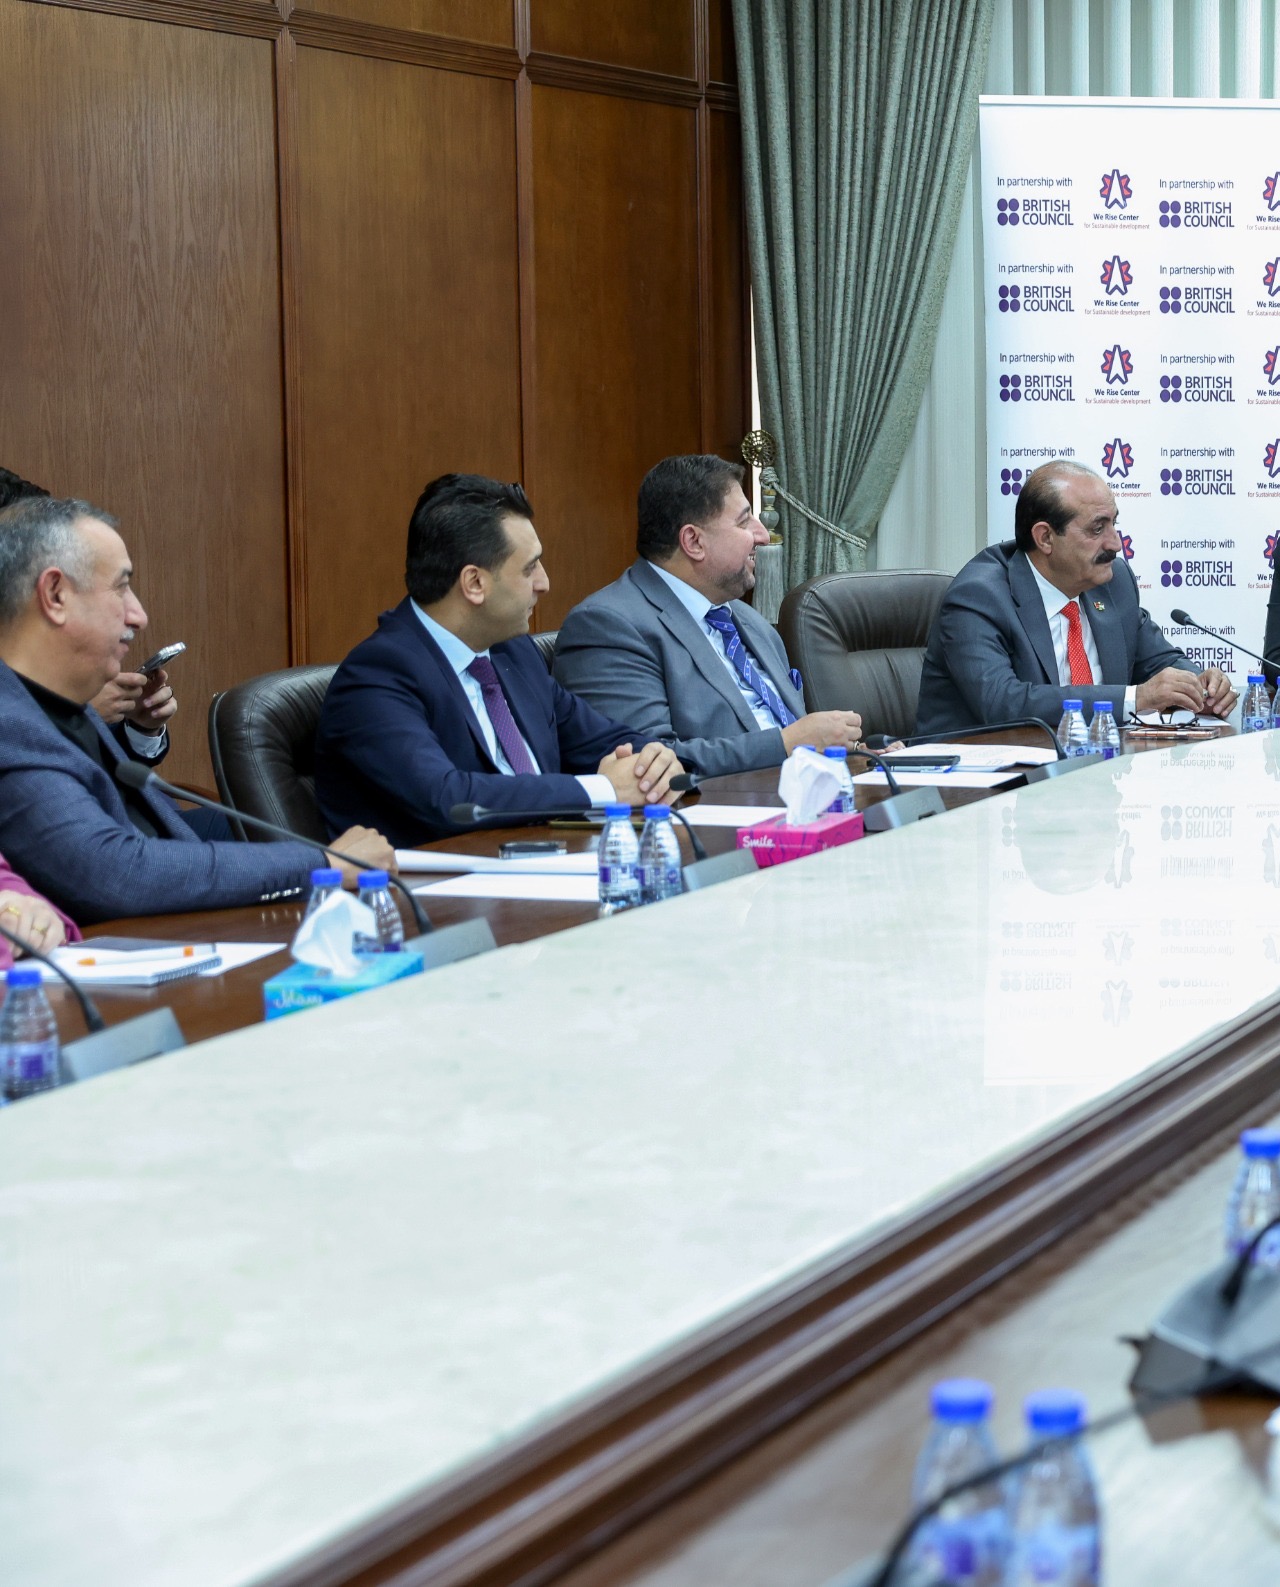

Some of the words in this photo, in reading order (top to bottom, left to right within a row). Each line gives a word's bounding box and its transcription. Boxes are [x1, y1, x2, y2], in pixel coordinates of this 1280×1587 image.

[997, 176, 1005, 187] In
[1007, 177, 1055, 189] partnership
[1056, 178, 1073, 187] with
[1160, 179, 1167, 189] In
[1170, 180, 1216, 191] partnership
[1218, 180, 1235, 189] with
[1023, 199, 1071, 213] BRITISH
[1185, 202, 1232, 215] BRITISH
[1022, 213, 1075, 226] COUNCIL
[1184, 215, 1235, 228] COUNCIL
[999, 264, 1007, 273] In
[1008, 264, 1055, 275] partnership
[1057, 264, 1074, 274] with
[1160, 265, 1168, 275] In
[1170, 265, 1217, 277] partnership
[1218, 266, 1235, 275] with
[1024, 286, 1072, 299] BRITISH
[1185, 288, 1233, 301] BRITISH
[1024, 299, 1075, 313] COUNCIL
[1184, 301, 1236, 314] COUNCIL
[1257, 301, 1267, 309] We
[1269, 301, 1280, 309] Rise
[1000, 353, 1008, 363] In
[1009, 353, 1057, 365] partnership
[1058, 353, 1075, 363] with
[1161, 354, 1168, 364] In
[1170, 354, 1217, 366] partnership
[1218, 354, 1235, 364] with
[1025, 375, 1073, 389] BRITISH
[1185, 376, 1233, 389] BRITISH
[1024, 389, 1076, 402] COUNCIL
[1120, 389, 1141, 397] Center
[1184, 390, 1236, 403] COUNCIL
[1001, 447, 1009, 457] In
[1010, 447, 1057, 459] partnership
[1059, 447, 1075, 457] with
[1161, 448, 1169, 457] In
[1170, 448, 1217, 459] partnership
[1218, 448, 1235, 457] with
[1186, 470, 1233, 483] BRITISH
[1185, 483, 1237, 496] COUNCIL
[1161, 540, 1169, 549] In
[1171, 539, 1217, 551] partnership
[1219, 539, 1235, 549] with
[1186, 561, 1233, 574] BRITISH
[1186, 574, 1237, 587] COUNCIL
[1171, 626, 1217, 637] partnership
[1219, 625, 1235, 634] with
[1186, 648, 1233, 659] BRITISH
